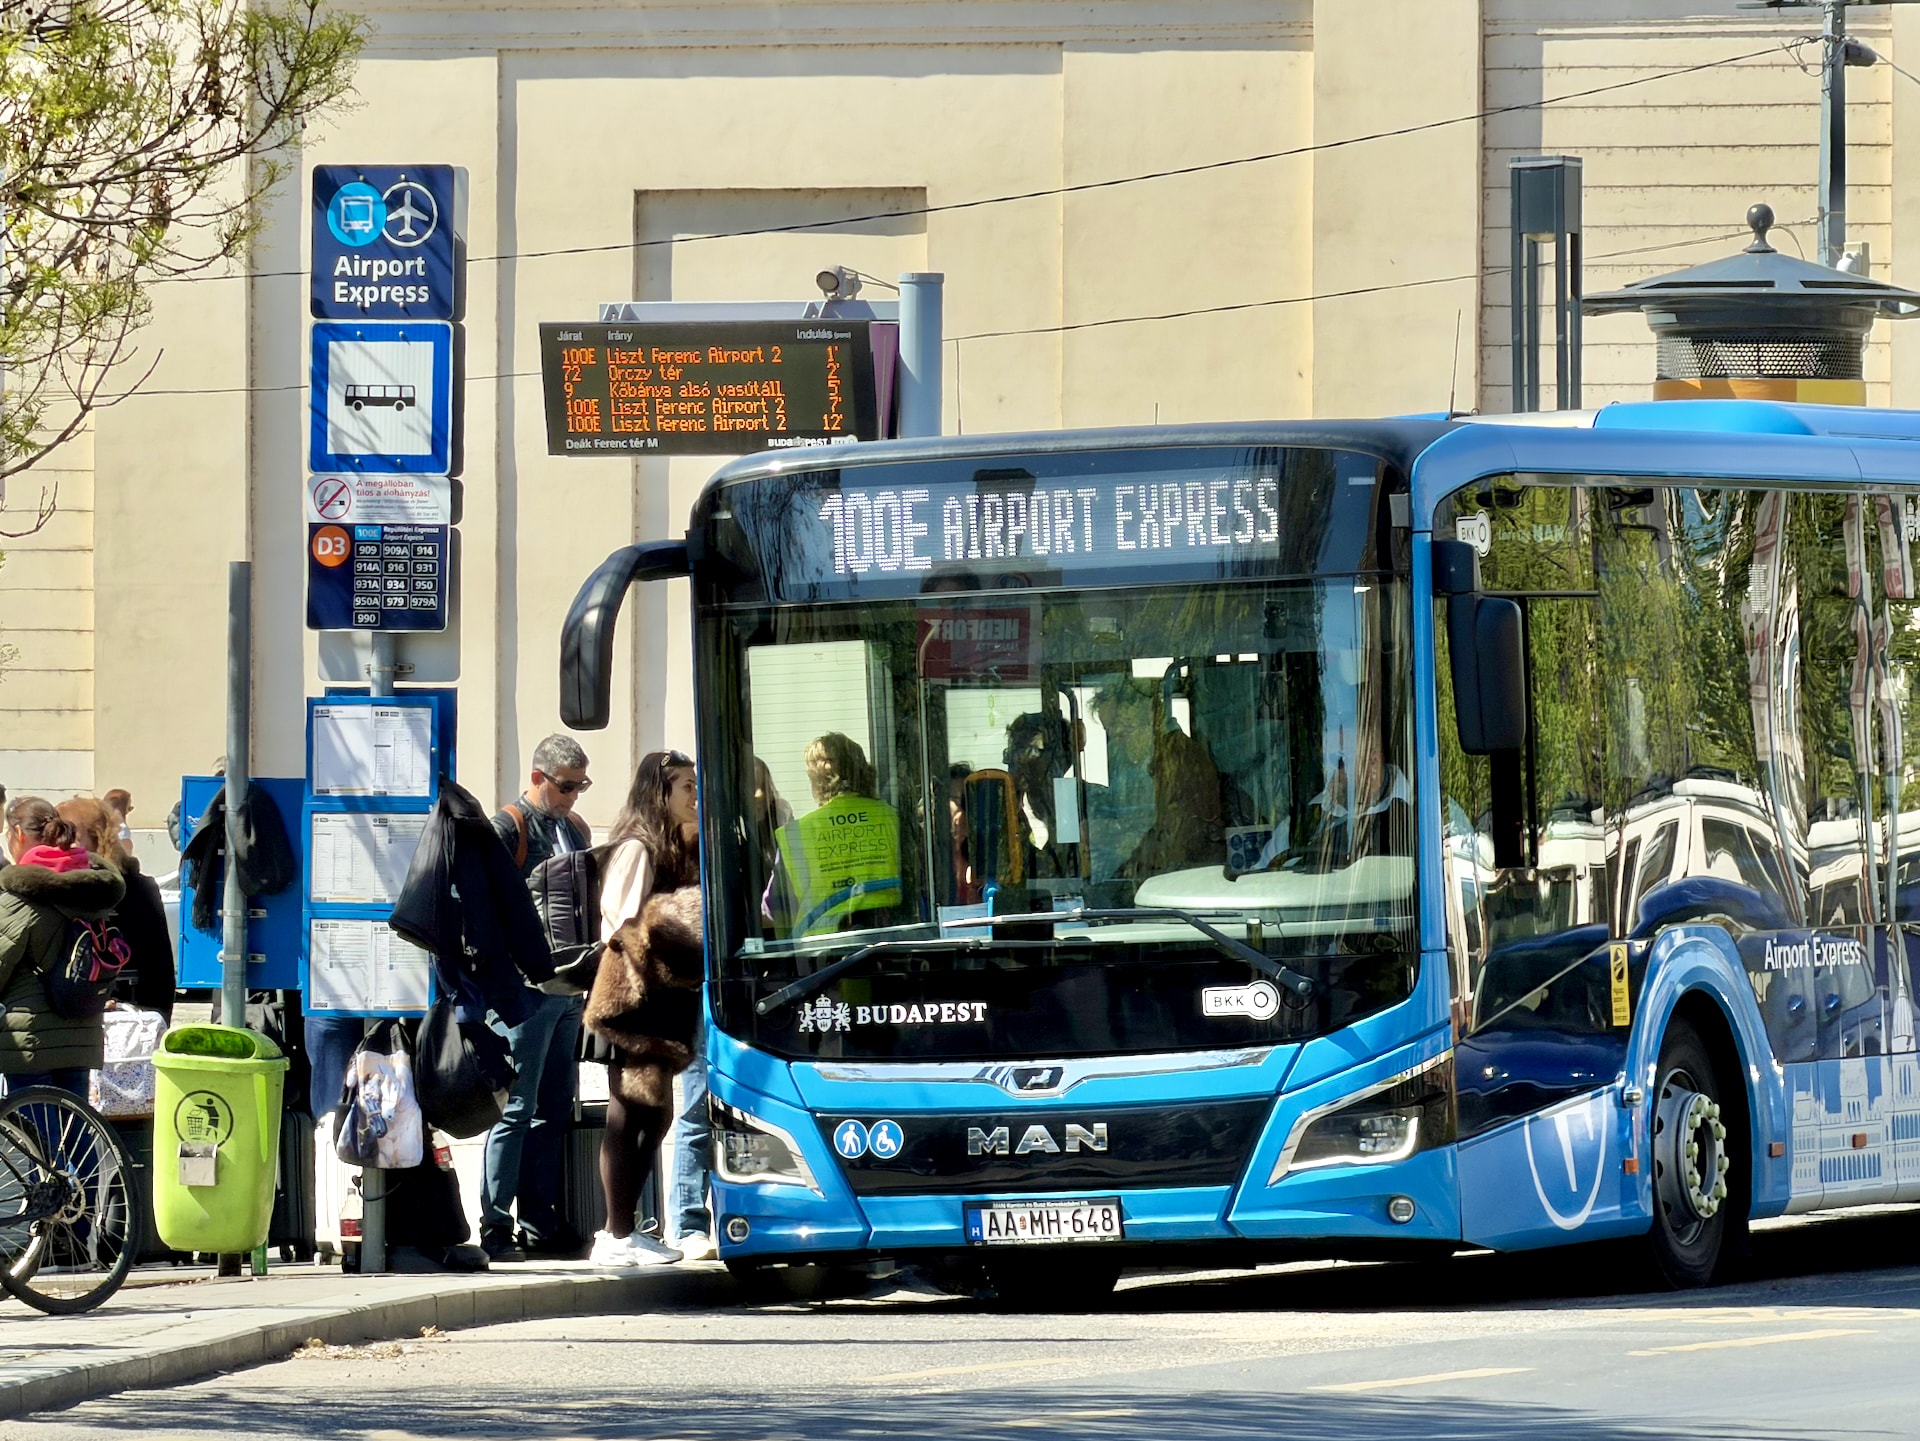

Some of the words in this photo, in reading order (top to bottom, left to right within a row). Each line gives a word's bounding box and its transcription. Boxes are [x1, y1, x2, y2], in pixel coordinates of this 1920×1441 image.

[334, 255, 426, 282] Airport
[334, 281, 429, 308] Express
[557, 330, 583, 341] Járat
[607, 330, 633, 342] Irány
[797, 329, 833, 340] Indulás
[562, 348, 597, 365] 100E
[606, 347, 646, 364] Liszt
[651, 347, 702, 364] Ferenc
[708, 346, 764, 364] Airport
[771, 346, 782, 363] 2
[562, 365, 582, 381] 72
[608, 365, 652, 382] Orczy
[659, 364, 683, 381] tér
[564, 381, 574, 398] 9
[679, 381, 711, 397] alsó
[566, 399, 600, 415] 100E
[611, 399, 649, 415] Liszt
[655, 399, 706, 415] Ferenc
[712, 398, 769, 414] Airport
[775, 397, 786, 414] 2
[567, 416, 602, 432] 100E
[612, 416, 651, 432] Liszt
[656, 416, 706, 432] Ferenc
[713, 415, 770, 432] Airport
[776, 415, 787, 431] 2
[565, 439, 592, 450] Deák
[594, 438, 628, 449] Ferenc
[629, 438, 645, 448] tér
[647, 438, 659, 447] M
[358, 529, 378, 537] 100E
[818, 489, 932, 574] 100E
[943, 487, 1098, 560] AIRPORT
[1115, 477, 1279, 550] EXPRESS
[1461, 527, 1476, 541] BKK
[317, 536, 346, 556] D3
[359, 546, 377, 554] 909
[384, 546, 409, 555] 909A
[416, 546, 433, 555] 914
[356, 563, 380, 571] 914A
[388, 563, 404, 572] 916
[416, 564, 433, 572] 931
[356, 580, 379, 588] 931A
[386, 581, 405, 589] 934
[415, 581, 433, 590] 950
[355, 597, 379, 606] 950A
[386, 598, 405, 606] 979
[412, 598, 436, 607] 979A
[357, 613, 376, 622] 990
[829, 811, 869, 827] 100E
[817, 824, 886, 843] AIRPORT
[818, 838, 888, 861] EXPRESS
[1764, 938, 1810, 978] Airport
[1813, 937, 1861, 975] Express
[1214, 995, 1244, 1007] BKK
[856, 1002, 987, 1025] BUDAPEST
[967, 1122, 1108, 1156] MAN
[972, 1227, 980, 1237] H
